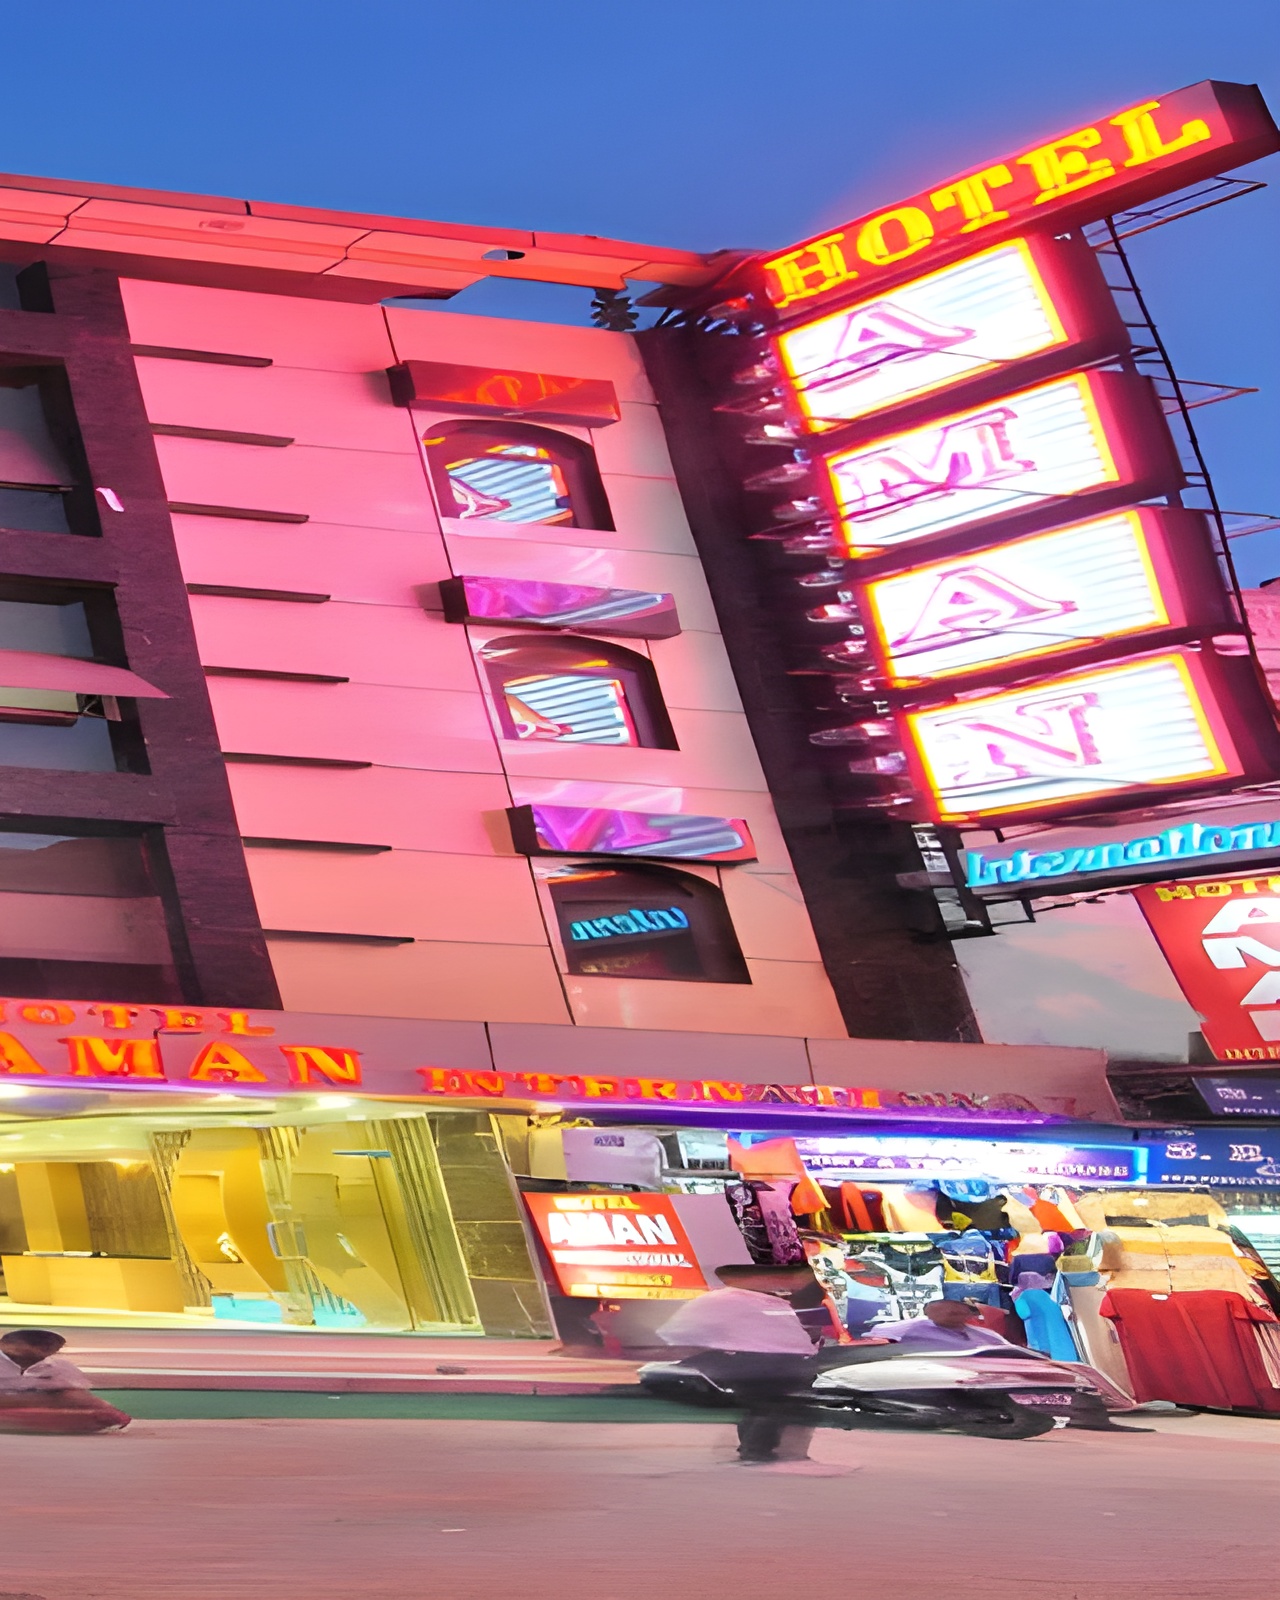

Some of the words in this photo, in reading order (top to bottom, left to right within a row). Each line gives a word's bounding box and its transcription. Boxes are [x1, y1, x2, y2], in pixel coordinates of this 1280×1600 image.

[763, 100, 1212, 309] HOTEL
[415, 1066, 1088, 1118] INTERNATI
[547, 1211, 678, 1246] AMAN
